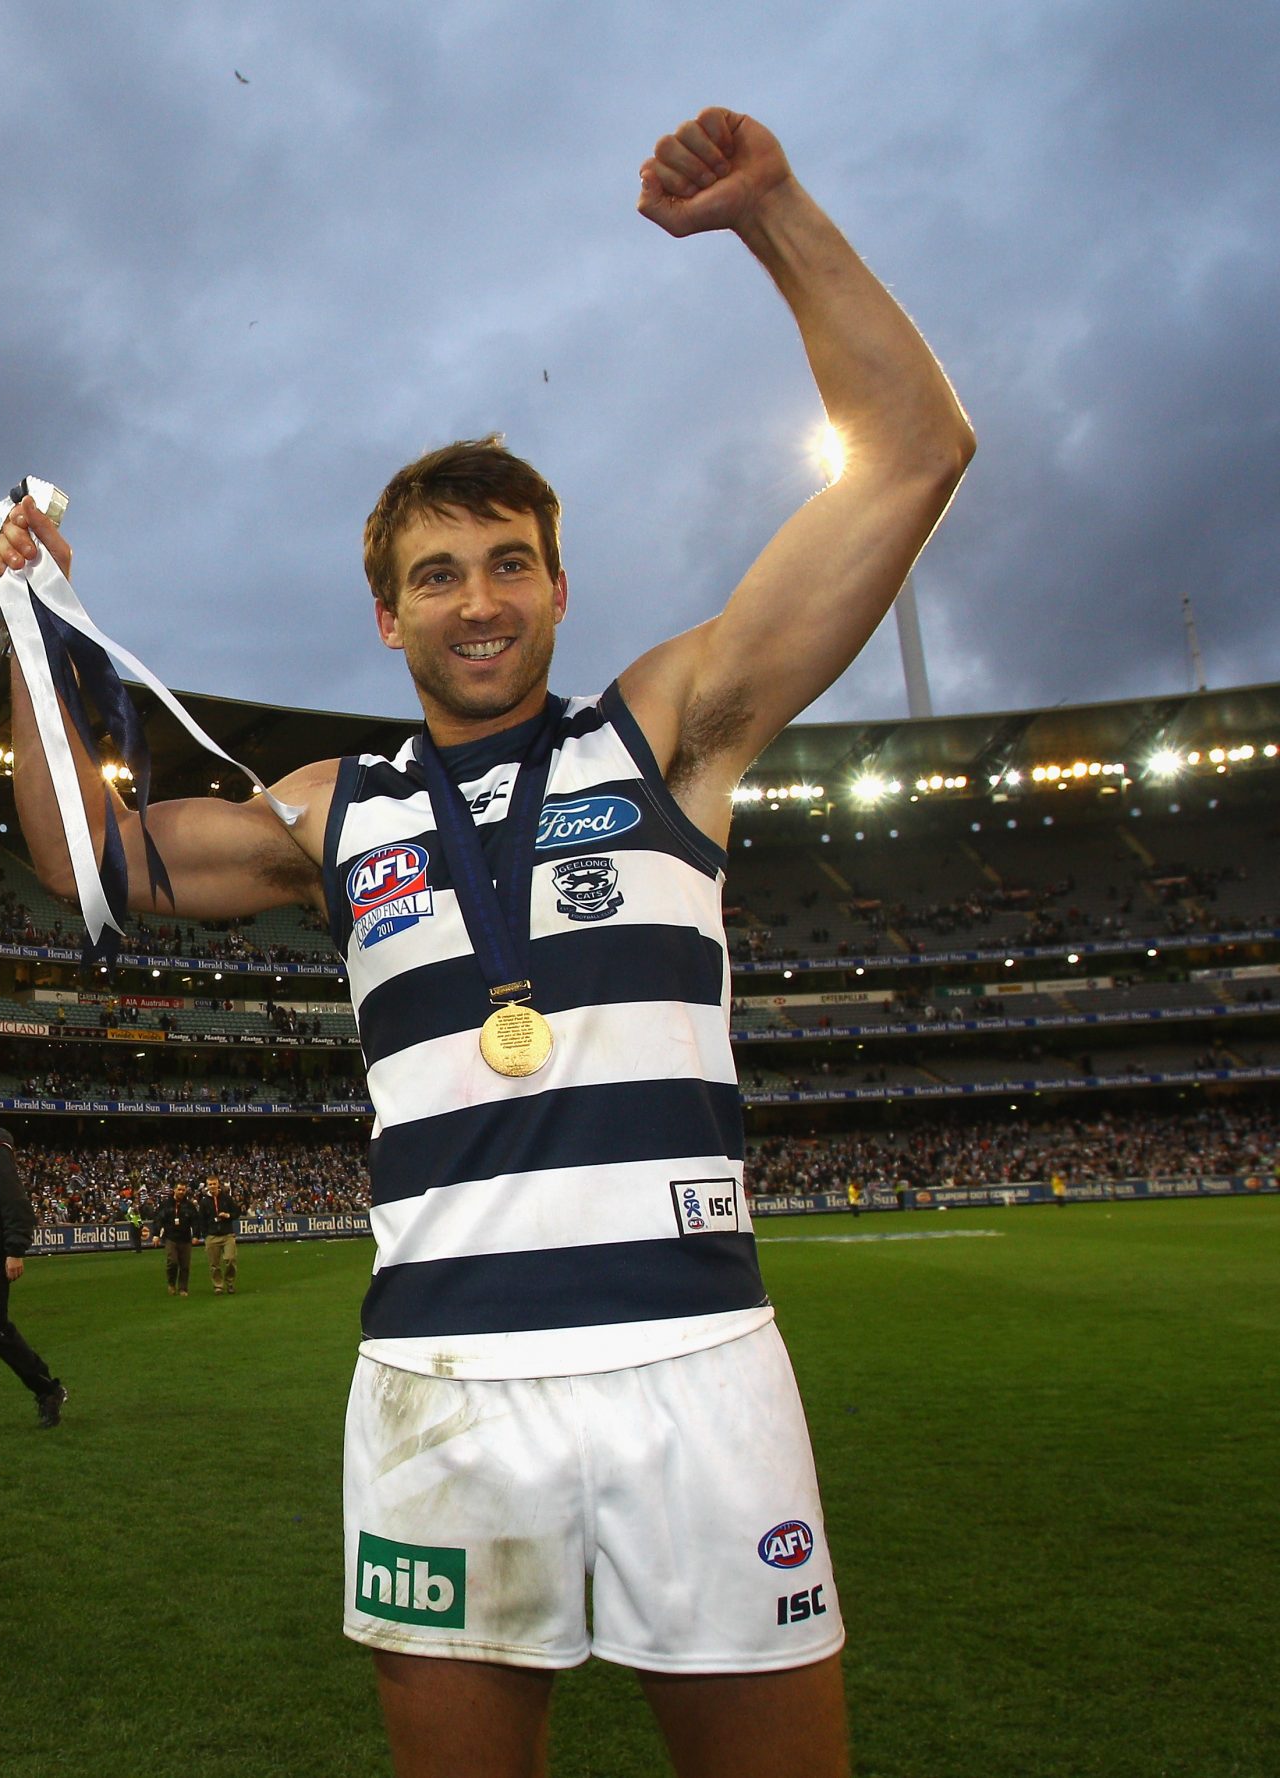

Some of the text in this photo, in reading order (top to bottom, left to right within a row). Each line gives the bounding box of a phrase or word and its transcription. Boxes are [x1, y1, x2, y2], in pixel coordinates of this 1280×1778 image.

[471, 781, 509, 814] SC
[536, 803, 617, 844] Ford
[558, 860, 608, 873] GEELONG
[354, 851, 420, 900] AFL
[576, 890, 603, 900] CATS
[354, 894, 429, 943] GRAND FINAL
[376, 920, 395, 938] 2011
[23, 946, 38, 957] Sun
[48, 949, 73, 960] Herald
[174, 959, 190, 968] Sun
[198, 960, 238, 971] Herald Sun
[248, 963, 288, 973] Herald Sun
[297, 965, 338, 974] Herald Sun
[126, 998, 138, 1006] AIA
[141, 999, 170, 1008] Australia
[821, 994, 869, 1003] CATERPILLAR
[14, 1099, 56, 1111] Herald Sun
[65, 1101, 108, 1112] Herald Sun
[118, 1103, 160, 1112] Herald Sun
[169, 1103, 211, 1113] Herald Sun
[220, 1104, 263, 1113] Herald Sun
[322, 1104, 365, 1113] Herald Sun
[1061, 1182, 1103, 1197] erald
[748, 1197, 814, 1212] Herald Sun
[872, 1193, 897, 1205] Sun
[709, 1197, 732, 1217] ISC
[240, 1219, 299, 1235] Herald Sun
[308, 1215, 368, 1232] Herald Sun
[45, 1229, 64, 1246] Sun
[73, 1227, 130, 1244] Herald Sun
[767, 1529, 812, 1561] AFL
[362, 1556, 455, 1614] nib
[777, 1584, 827, 1626] ISC
